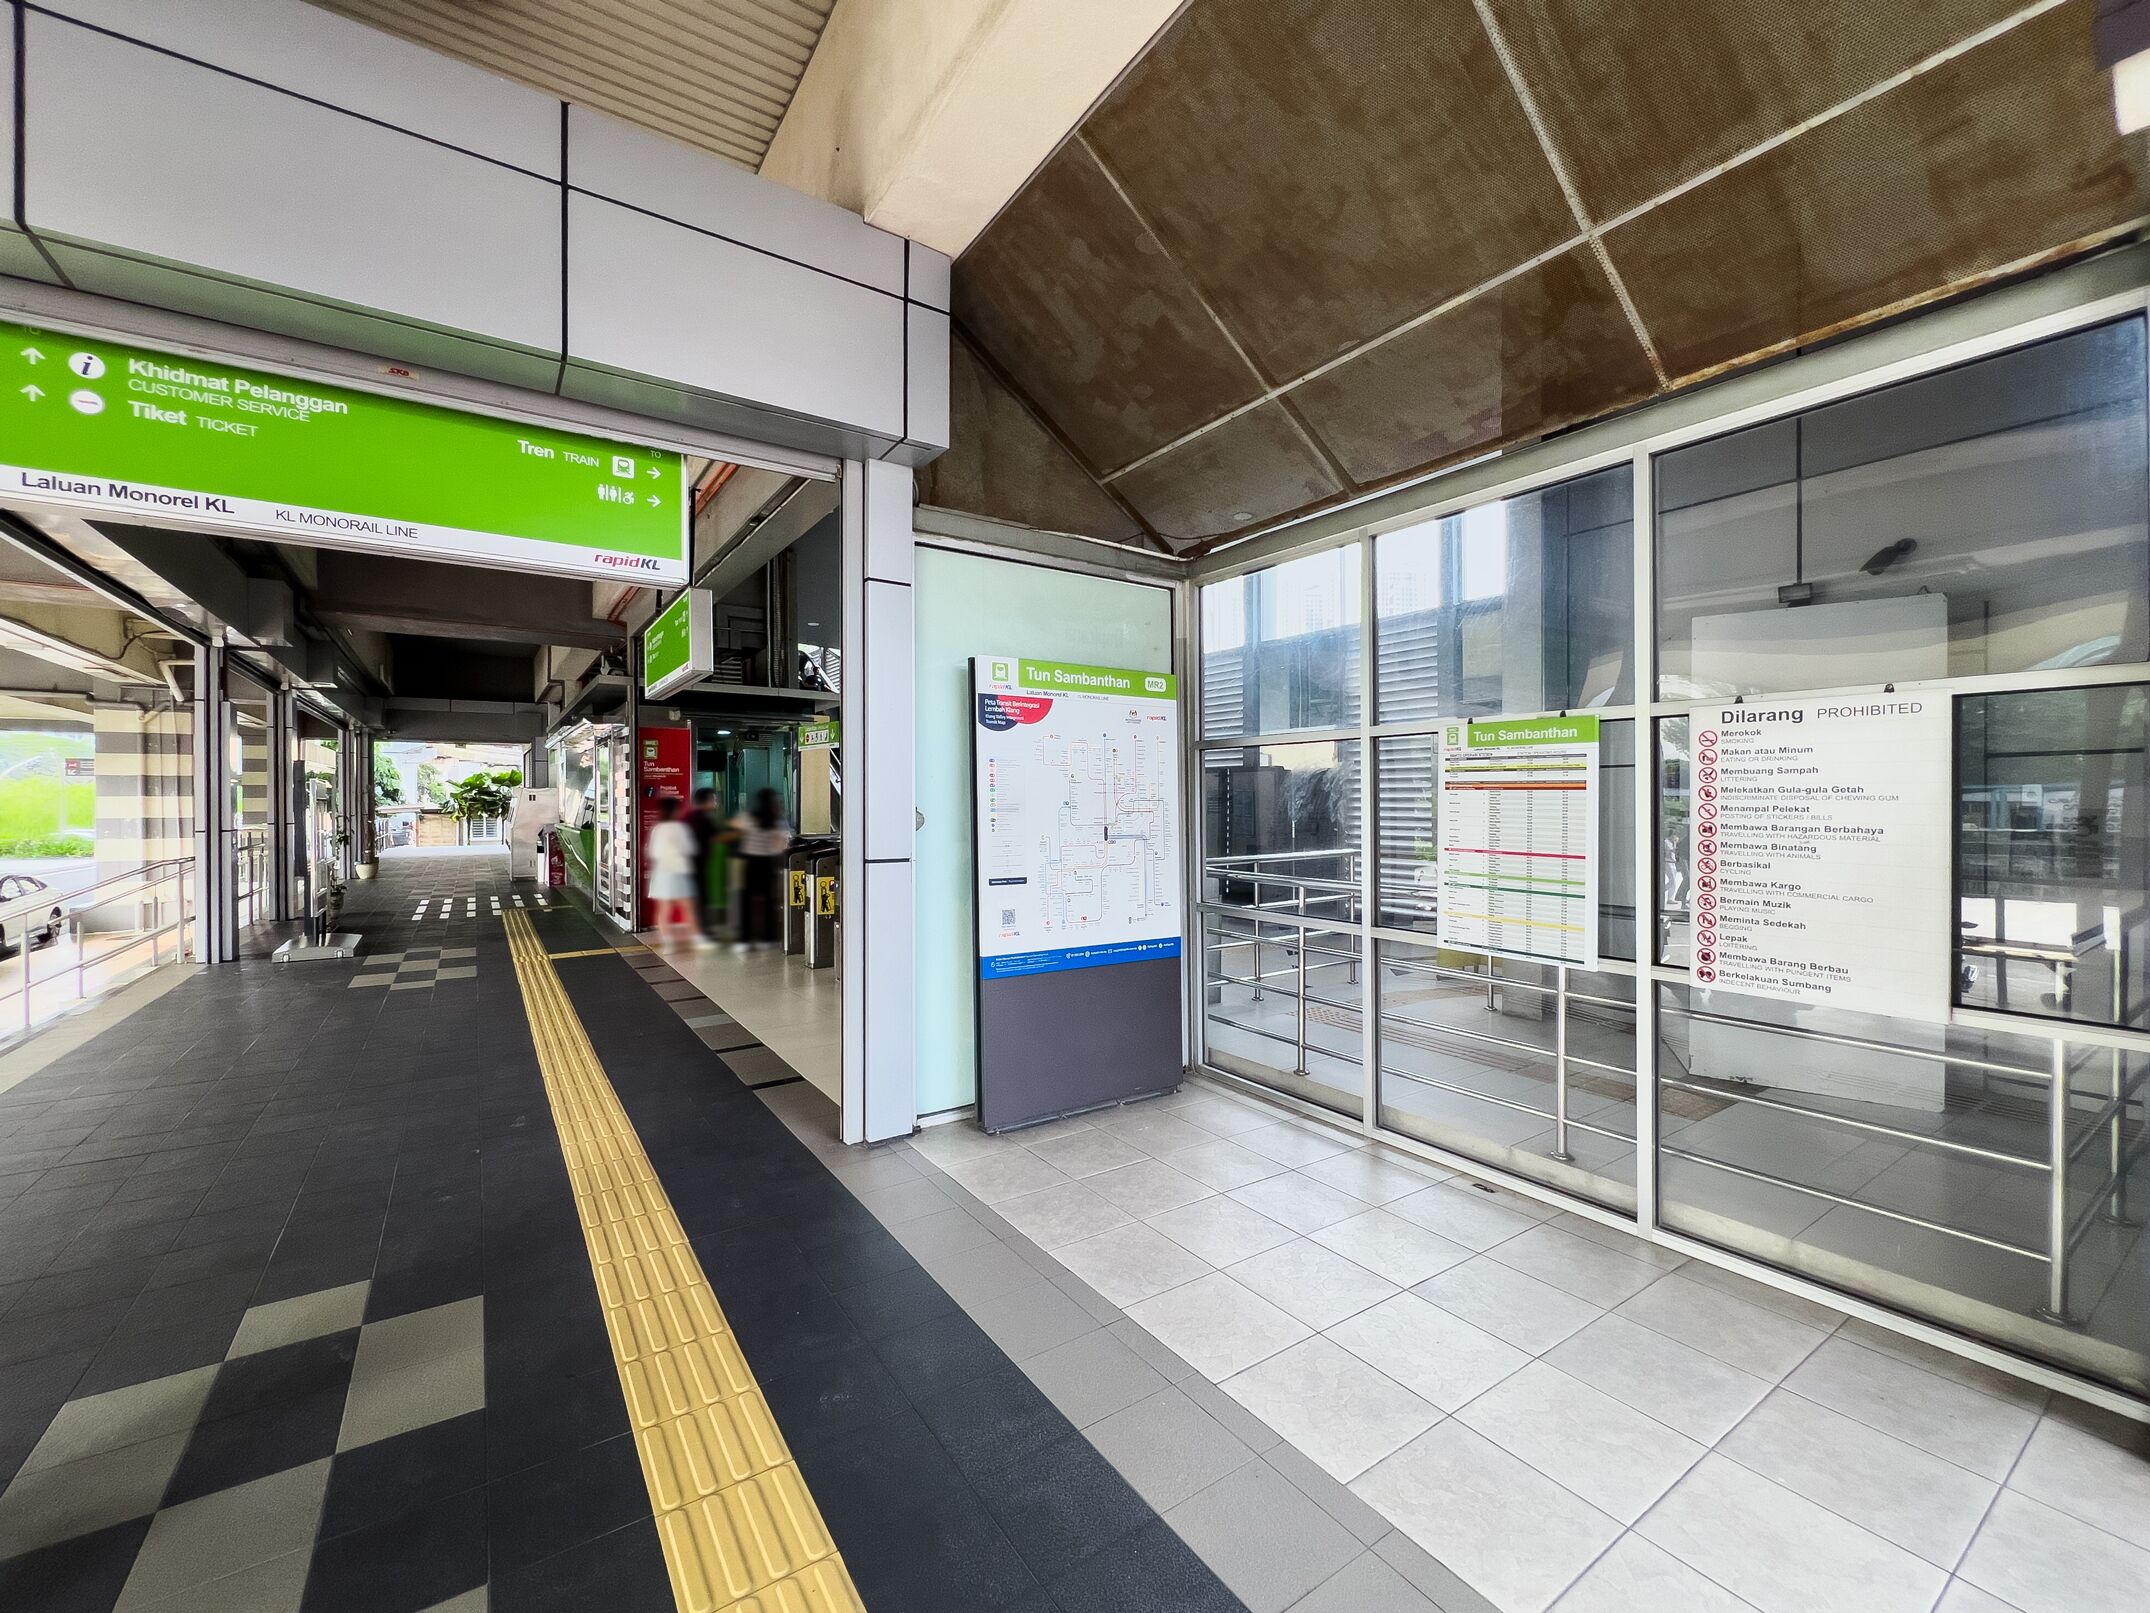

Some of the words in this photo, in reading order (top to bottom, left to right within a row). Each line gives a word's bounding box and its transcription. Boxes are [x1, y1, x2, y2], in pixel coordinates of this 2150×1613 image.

[128, 358, 229, 392] Khidmat
[234, 379, 348, 414] Pelanggan
[128, 378, 233, 408] CUSTOMER
[238, 399, 310, 422] SERVICE
[128, 400, 187, 425] Tiket
[196, 416, 258, 437] TICKET
[517, 439, 554, 459] Tren
[562, 451, 599, 467] TRAIN
[22, 472, 101, 496] Laluan
[109, 483, 198, 509] Monorel
[205, 497, 235, 514] KL
[276, 509, 296, 522] KL
[300, 512, 383, 534] MONORAIL
[386, 525, 418, 538] LINE
[594, 554, 661, 570] rapidKL
[1026, 666, 1050, 682] Tun
[1054, 670, 1130, 688] Sambanthan
[1148, 680, 1164, 689] MR2
[1721, 709, 1803, 724] Dilarang
[1817, 703, 1922, 718] PROHIBITED
[1474, 731, 1495, 742] Tun
[1498, 727, 1577, 740] Sambanthan
[1721, 729, 1762, 737] Merokok
[1779, 746, 1813, 754] Minum
[1721, 768, 1774, 776] Membuang
[1777, 766, 1818, 775] Sampah
[1778, 786, 1828, 794] Gula-gula
[1721, 805, 1770, 813] Menampal
[1721, 823, 1768, 831] Membawa
[1771, 824, 1820, 833] Barangan
[1824, 826, 1884, 835] Berbahaya
[1787, 833, 1836, 841] HAZARDOUS
[1721, 842, 1768, 850] Membawa
[1771, 843, 1817, 853] Binatang
[1786, 852, 1821, 860] ANIMALS
[1720, 860, 1771, 869] Berbasikal
[1720, 879, 1768, 888] Membawa
[1771, 882, 1801, 891] Kargo
[1720, 887, 1764, 895] TRAVELLING
[1787, 892, 1840, 901] COMMERCIAL
[1842, 895, 1874, 903] CARGO
[1720, 896, 1759, 906] Bermain
[1763, 900, 1791, 909] Muzik
[1720, 905, 1749, 913] PLAYING
[1720, 915, 1760, 925] Meminta
[1763, 919, 1806, 930] Sedekah
[1720, 934, 1747, 943] Lepak
[1719, 942, 1757, 951] LOITERING
[1720, 952, 1766, 964] Membawa
[1770, 957, 1806, 970] Barang
[1810, 962, 1848, 974] Berbau
[1720, 960, 1763, 971] TRAVELLING
[1765, 965, 1784, 973] WITH
[1786, 968, 1823, 979] PUNGENT
[1826, 973, 1851, 982] ITEMS
[1720, 970, 1779, 984] Berkelakuan
[1782, 978, 1832, 993] Sumbang
[1720, 978, 1755, 988] INDECENT
[1757, 983, 1800, 995] BEHAVIOUR
